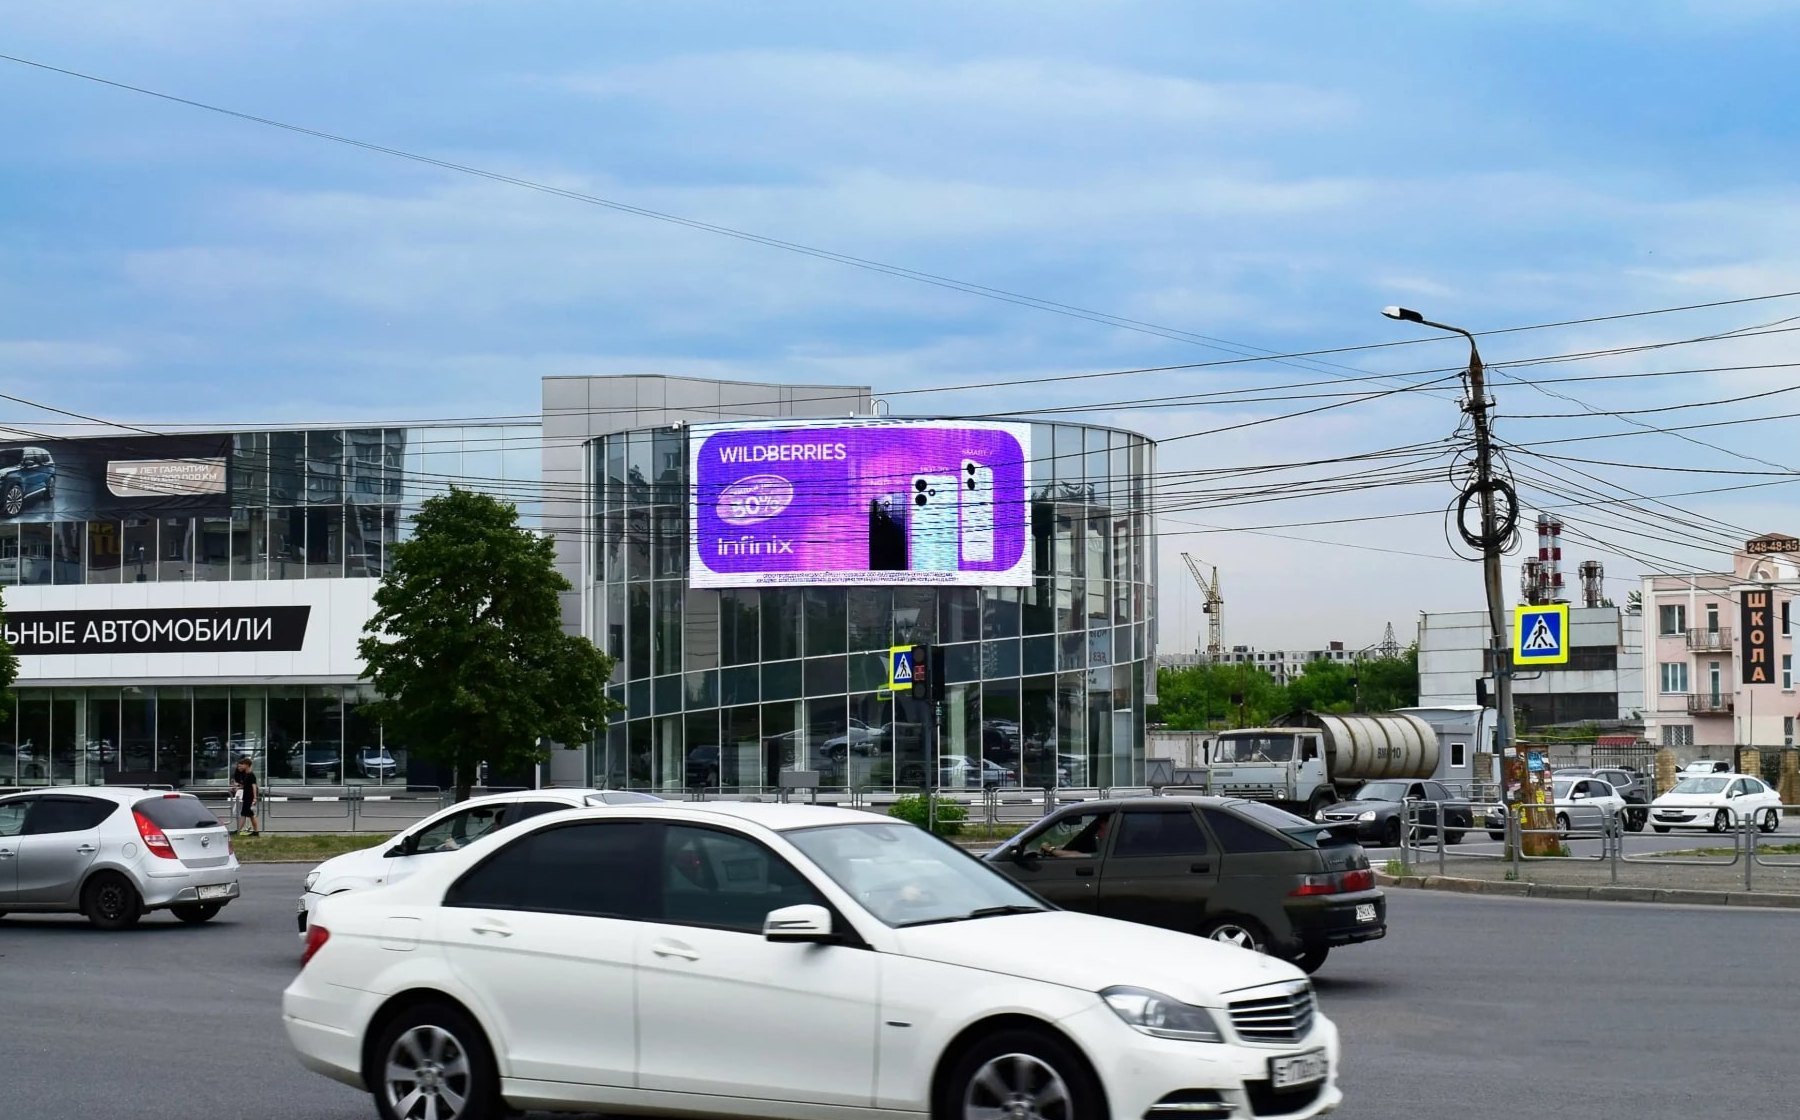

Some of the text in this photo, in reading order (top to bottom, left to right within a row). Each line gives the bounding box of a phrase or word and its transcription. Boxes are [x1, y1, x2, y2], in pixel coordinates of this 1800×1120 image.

[719, 443, 847, 463] WILDBERRIES
[139, 464, 210, 474] ЛЕТ ГАРАНТИИ
[0, 617, 272, 645] ЬНЫЕ АВТОМОБИЛИ
[1747, 592, 1766, 682] ШКОЛА
